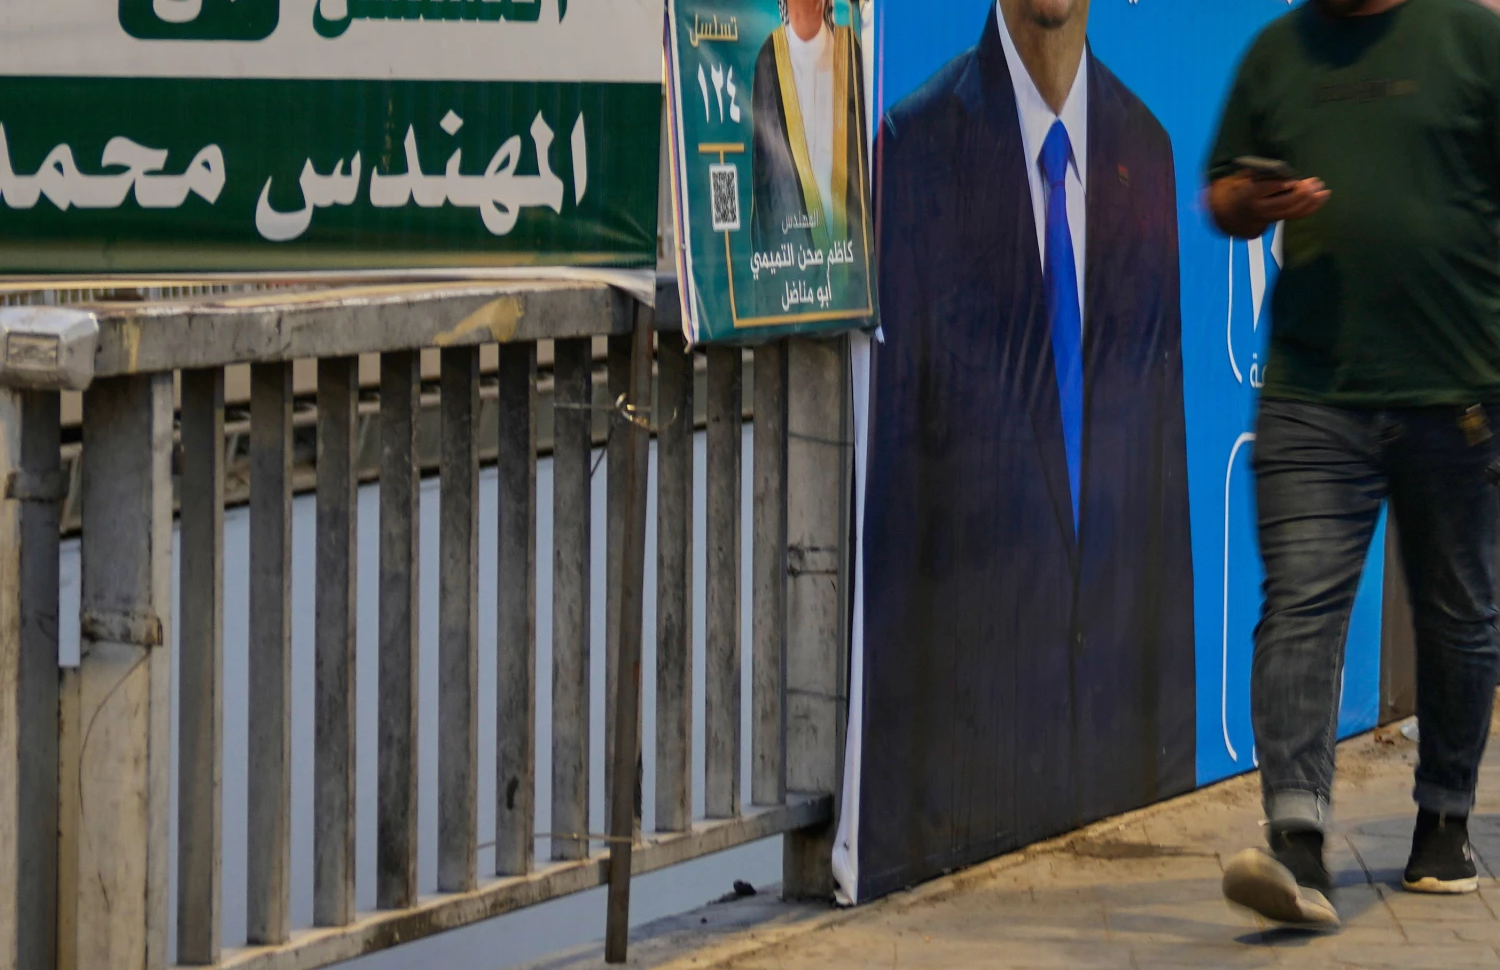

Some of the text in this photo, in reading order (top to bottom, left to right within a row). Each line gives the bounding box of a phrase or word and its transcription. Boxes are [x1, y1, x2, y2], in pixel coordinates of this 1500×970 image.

[689, 14, 739, 48] تسلسل
[697, 61, 741, 124] ١٢٤
[255, 108, 588, 243] المهندس
[750, 243, 795, 281] التميمي
[826, 239, 854, 272] كاظم
[781, 273, 832, 312] أبو مناضل
